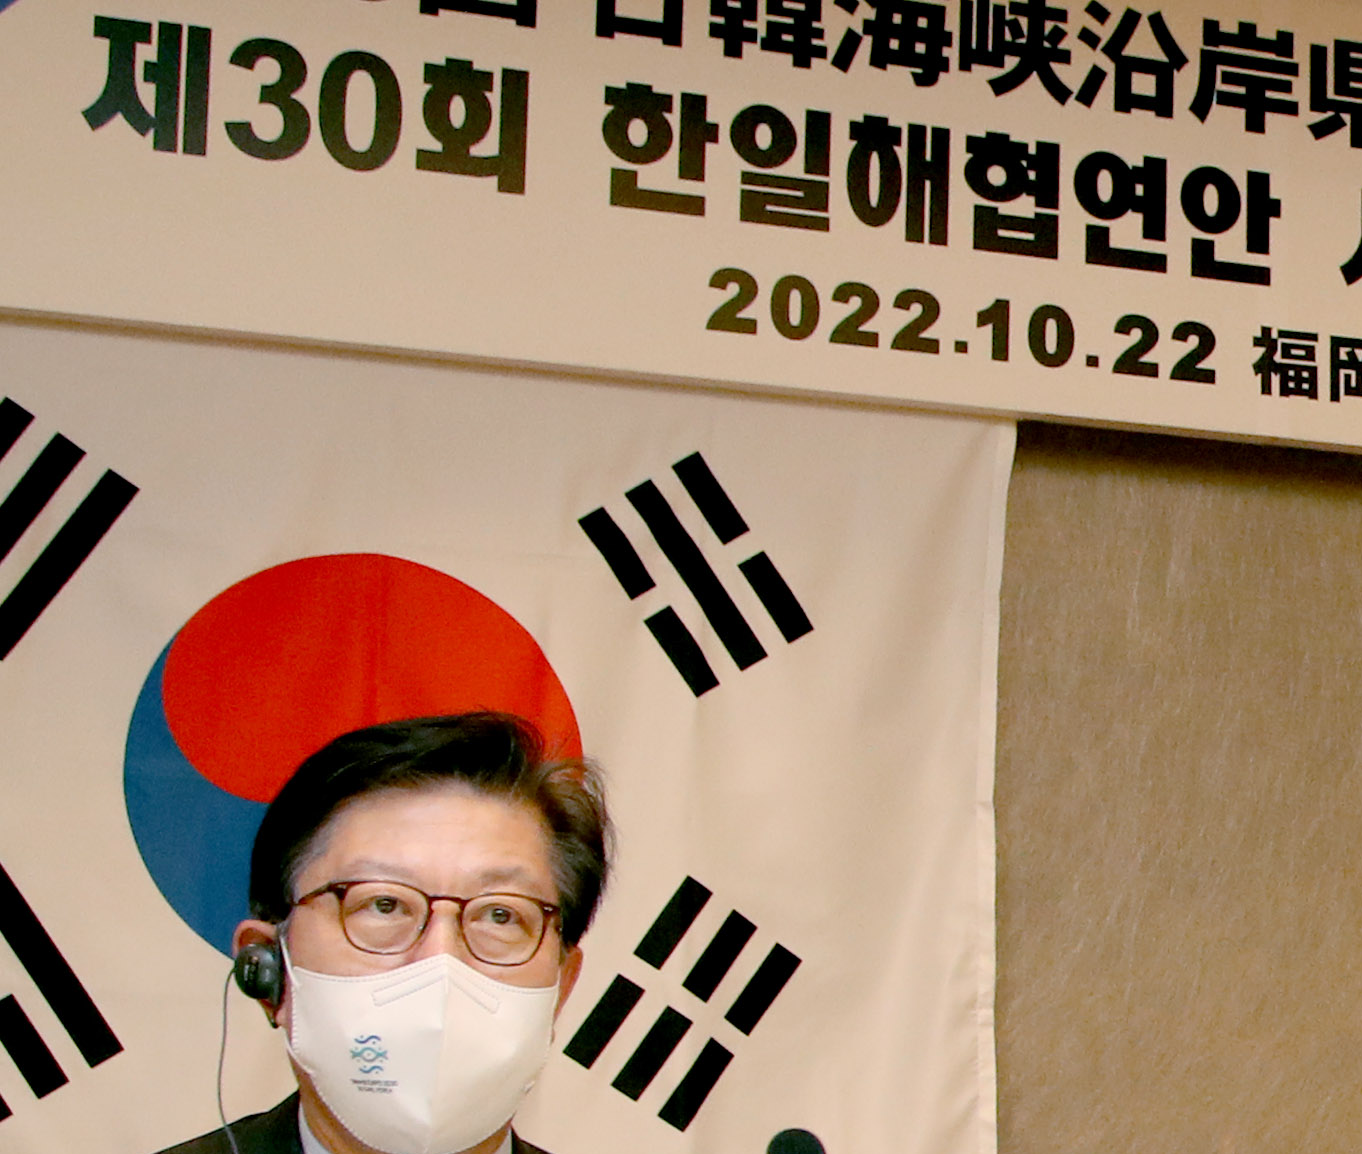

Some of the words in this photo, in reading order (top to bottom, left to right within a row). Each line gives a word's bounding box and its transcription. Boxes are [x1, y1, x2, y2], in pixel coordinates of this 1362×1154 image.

[81, 14, 530, 195] 제30회
[600, 81, 1282, 287] 한일해협연안
[705, 267, 1217, 386] 2022.10.22
